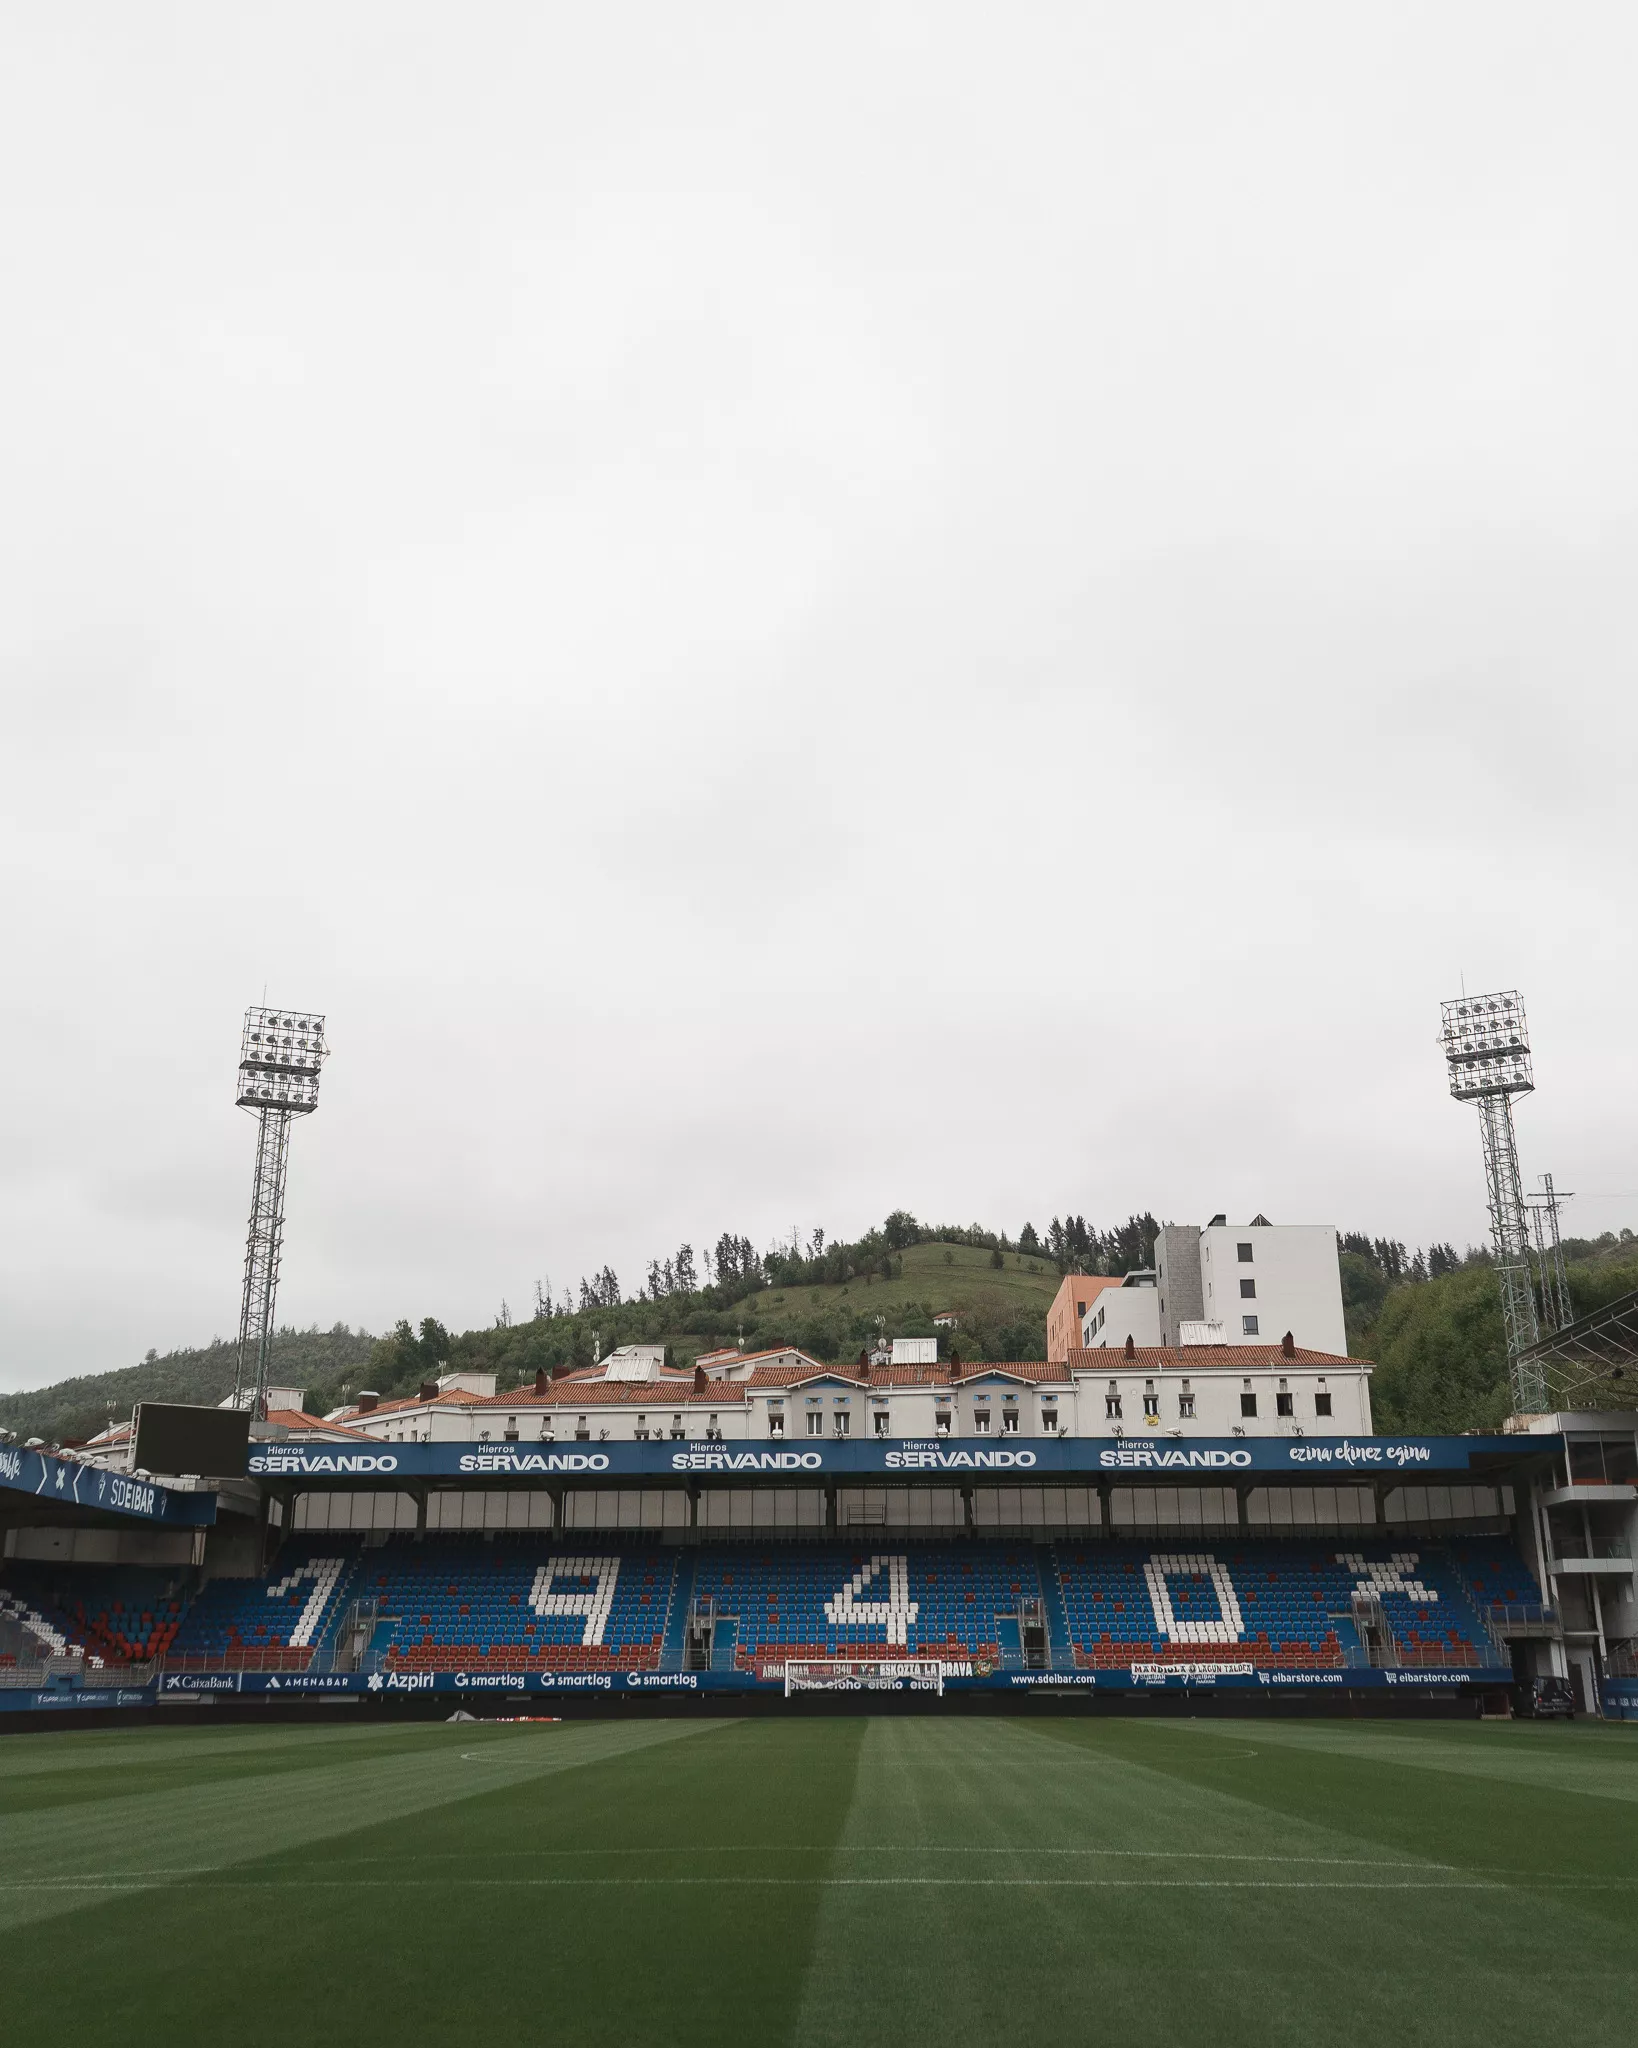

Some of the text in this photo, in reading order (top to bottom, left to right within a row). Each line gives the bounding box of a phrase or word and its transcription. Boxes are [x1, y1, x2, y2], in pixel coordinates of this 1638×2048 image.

[267, 1446, 304, 1455] Hierros
[478, 1444, 515, 1453] Hierros
[690, 1442, 727, 1452] Hierros
[903, 1441, 940, 1450] Hierros
[1117, 1440, 1155, 1449] Hierros
[884, 1450, 1037, 1468] SERVANDO
[1100, 1449, 1252, 1467] SERVANDO
[1289, 1440, 1430, 1466] ezina ekinez egina
[248, 1455, 398, 1473] SERVANDO
[459, 1454, 610, 1472] SERVANDO
[672, 1452, 823, 1470] SERVANDO
[762, 1664, 809, 1678] ARMAINAK
[880, 1662, 973, 1677] ESKOZIA LA BRAVA
[182, 1675, 234, 1689] CaixaBank
[285, 1677, 349, 1687] AMENABAR
[386, 1671, 435, 1692] Azpiri
[471, 1673, 525, 1689] smartlog
[557, 1672, 612, 1688] smartlog
[643, 1672, 698, 1688] smartlog
[1011, 1674, 1096, 1685] www.sdeibar.com
[1272, 1673, 1343, 1683] eibarstore.com
[1399, 1673, 1470, 1683] eibarstore.com
